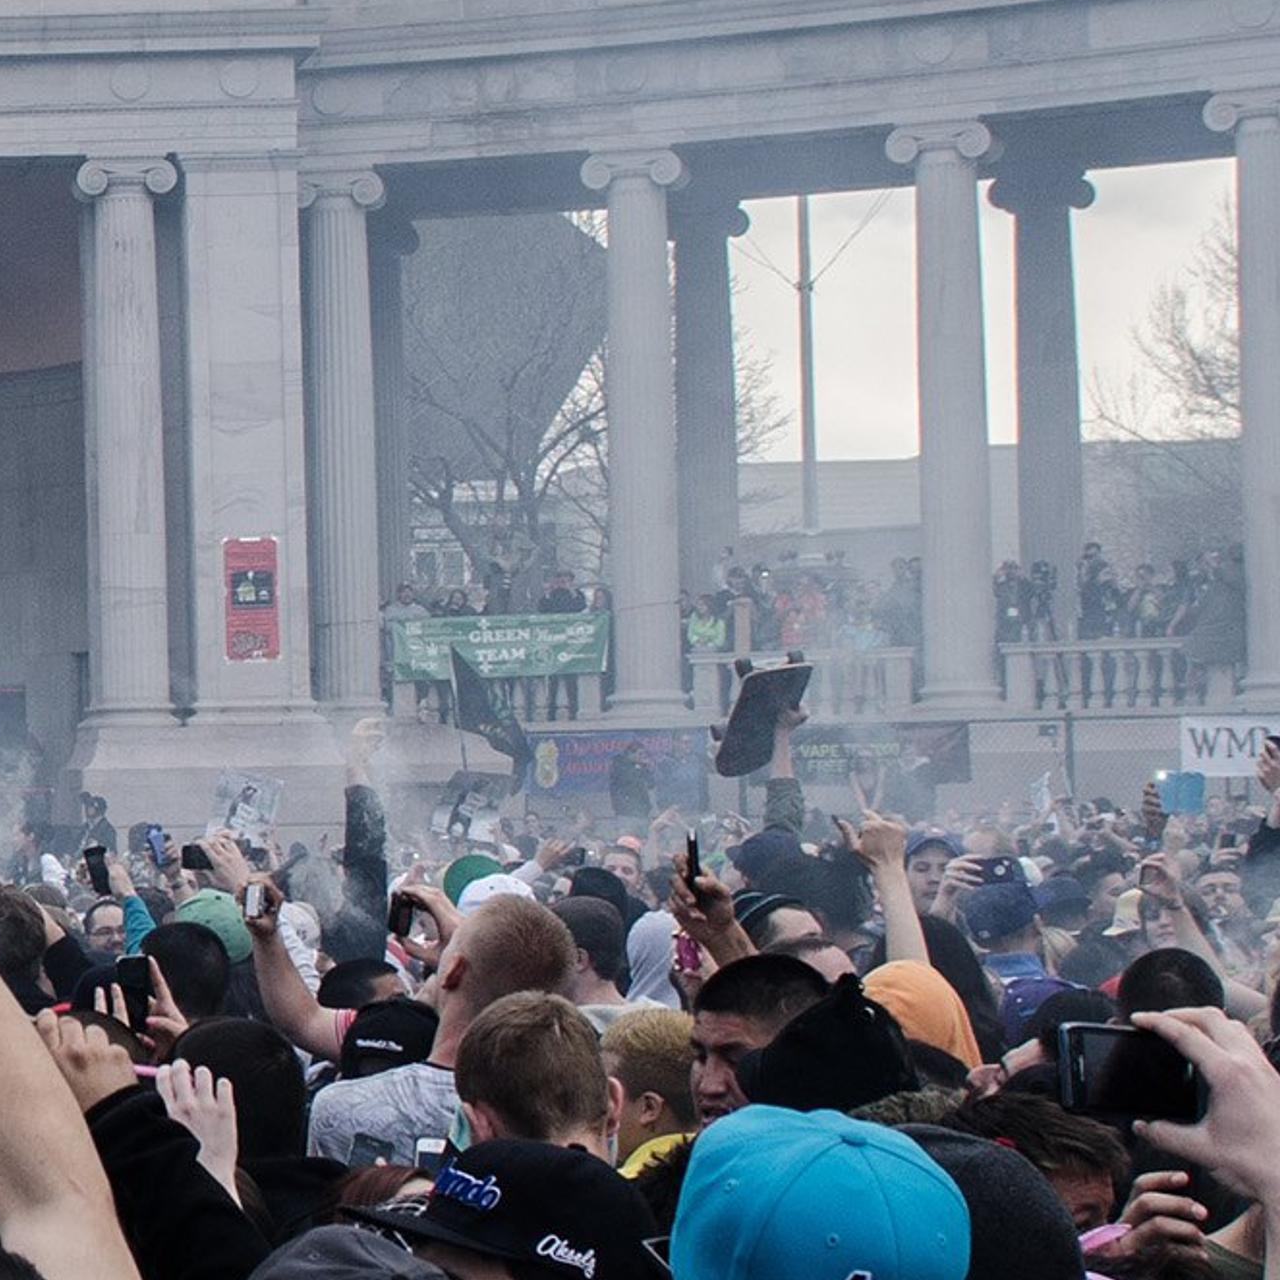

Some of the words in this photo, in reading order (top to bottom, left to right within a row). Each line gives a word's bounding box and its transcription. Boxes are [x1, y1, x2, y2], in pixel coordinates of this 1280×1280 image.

[468, 627, 531, 643] GREEN
[475, 647, 527, 662] TEAM
[798, 744, 840, 758] VAPE
